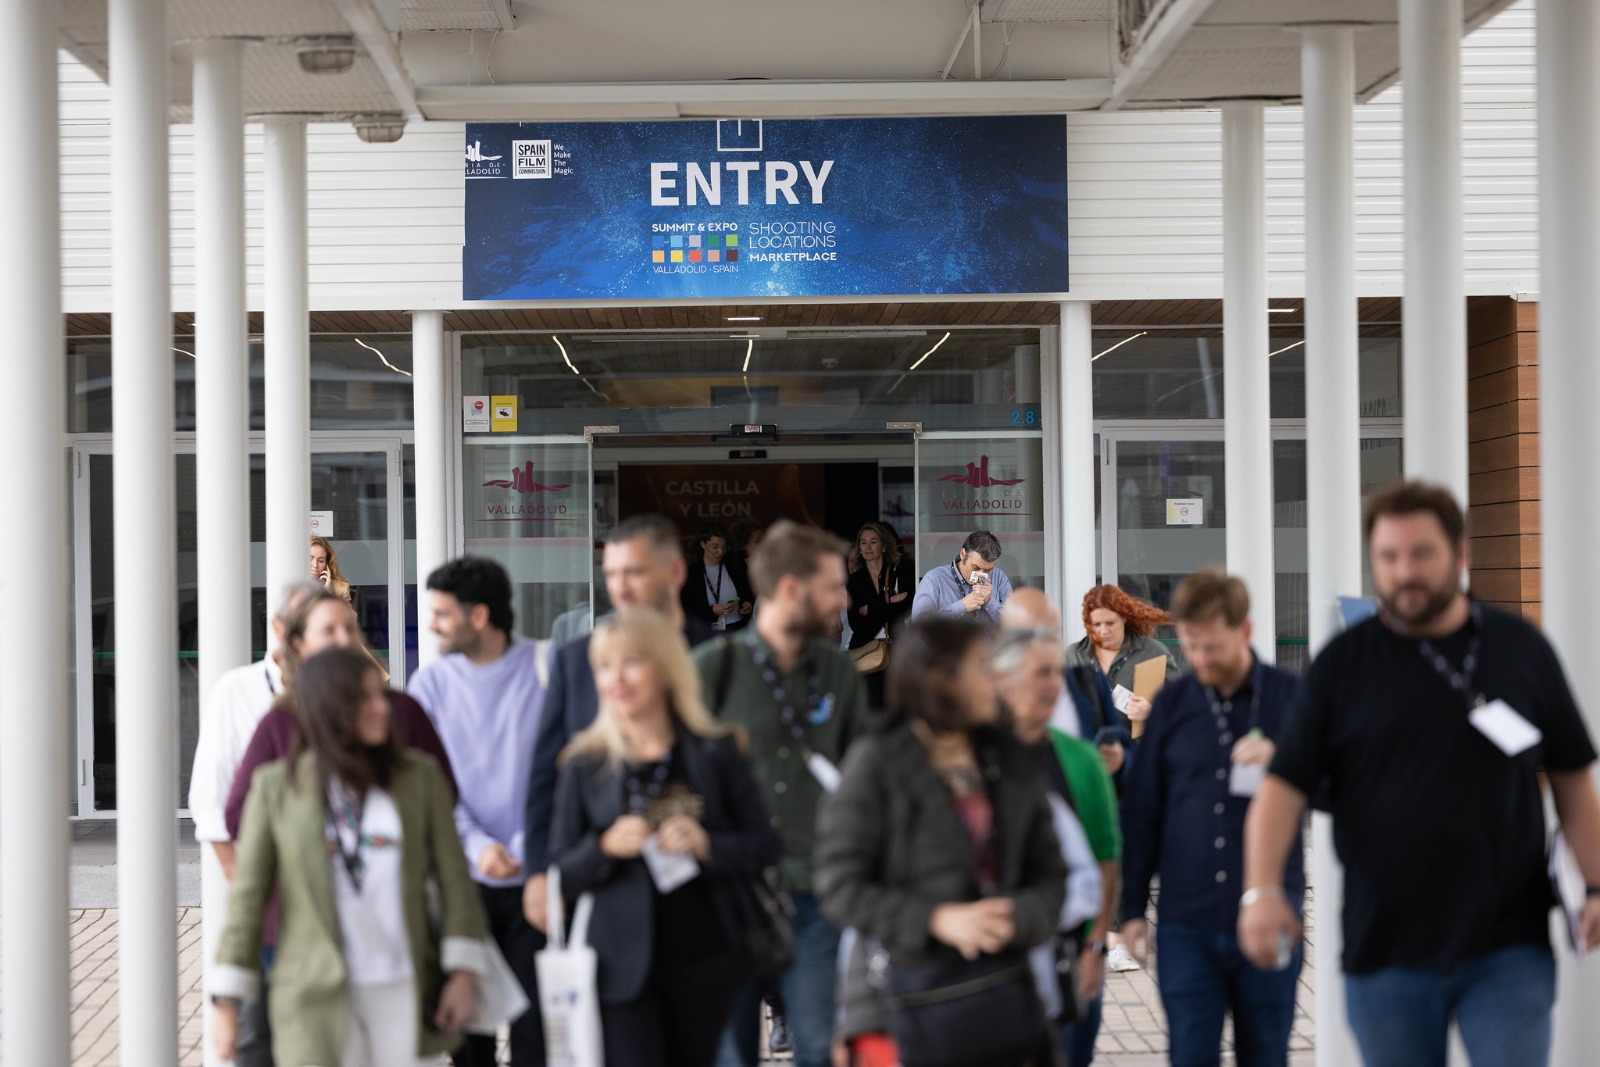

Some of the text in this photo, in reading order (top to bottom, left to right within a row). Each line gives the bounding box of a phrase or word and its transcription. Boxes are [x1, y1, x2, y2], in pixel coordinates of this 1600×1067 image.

[518, 144, 546, 156] SPAIN
[553, 143, 565, 151] We
[553, 151, 572, 159] Make
[518, 158, 546, 167] FILM
[553, 159, 567, 167] The
[553, 167, 574, 176] Magic
[650, 160, 835, 206] ENTRY
[651, 222, 739, 232] SUMMIT & EXPO
[749, 221, 837, 235] SHOOTING
[749, 235, 837, 249] LOCATIONS
[749, 252, 838, 262] MARKETPLACE
[652, 264, 739, 274] VALLADOLID SPAIN
[665, 480, 760, 496] CASTILLA
[487, 504, 568, 515] VALLADOLID
[680, 498, 750, 517] Y LEÓN
[943, 499, 1023, 510] VALLADOLID
